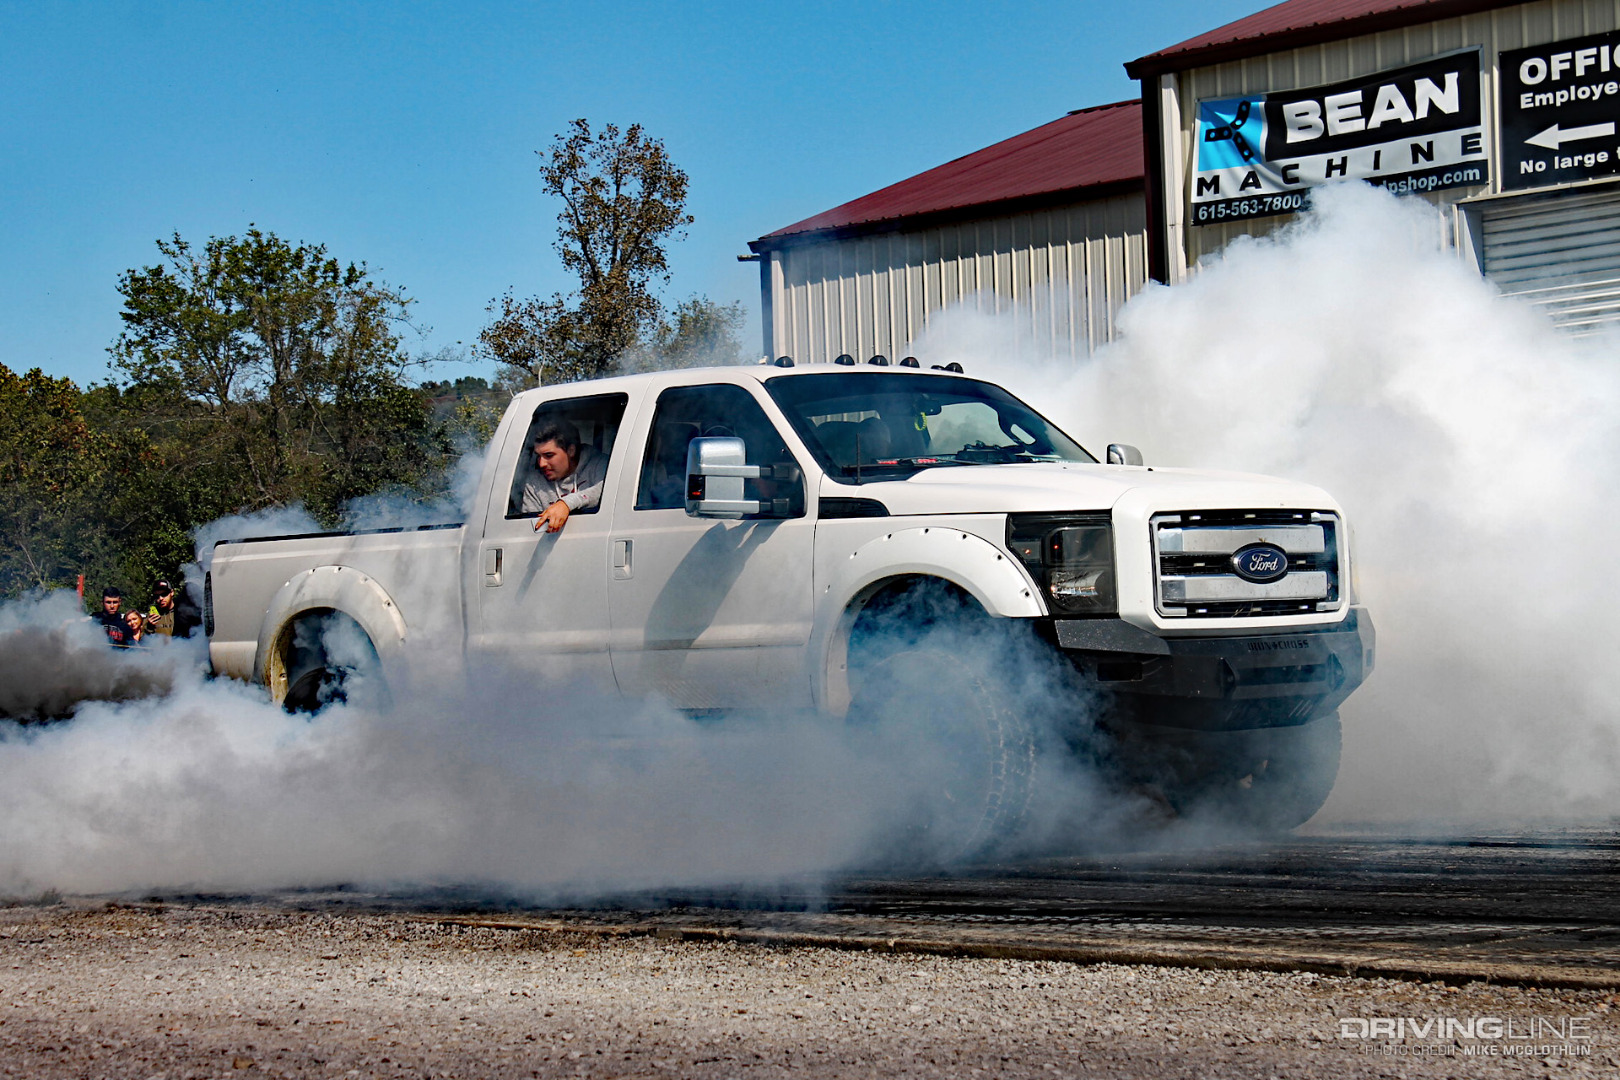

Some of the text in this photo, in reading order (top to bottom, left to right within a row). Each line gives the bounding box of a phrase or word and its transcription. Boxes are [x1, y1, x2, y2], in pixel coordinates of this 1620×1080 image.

[1519, 43, 1620, 86] OFFI
[1282, 73, 1460, 144] BEAN
[1520, 81, 1620, 110] Employe
[1196, 132, 1483, 198] MACHINE
[1520, 159, 1547, 175] No
[1554, 151, 1609, 168] large
[1198, 193, 1302, 221] 615-563-7800
[1249, 553, 1279, 572] Ford
[1277, 639, 1310, 650] CROSS
